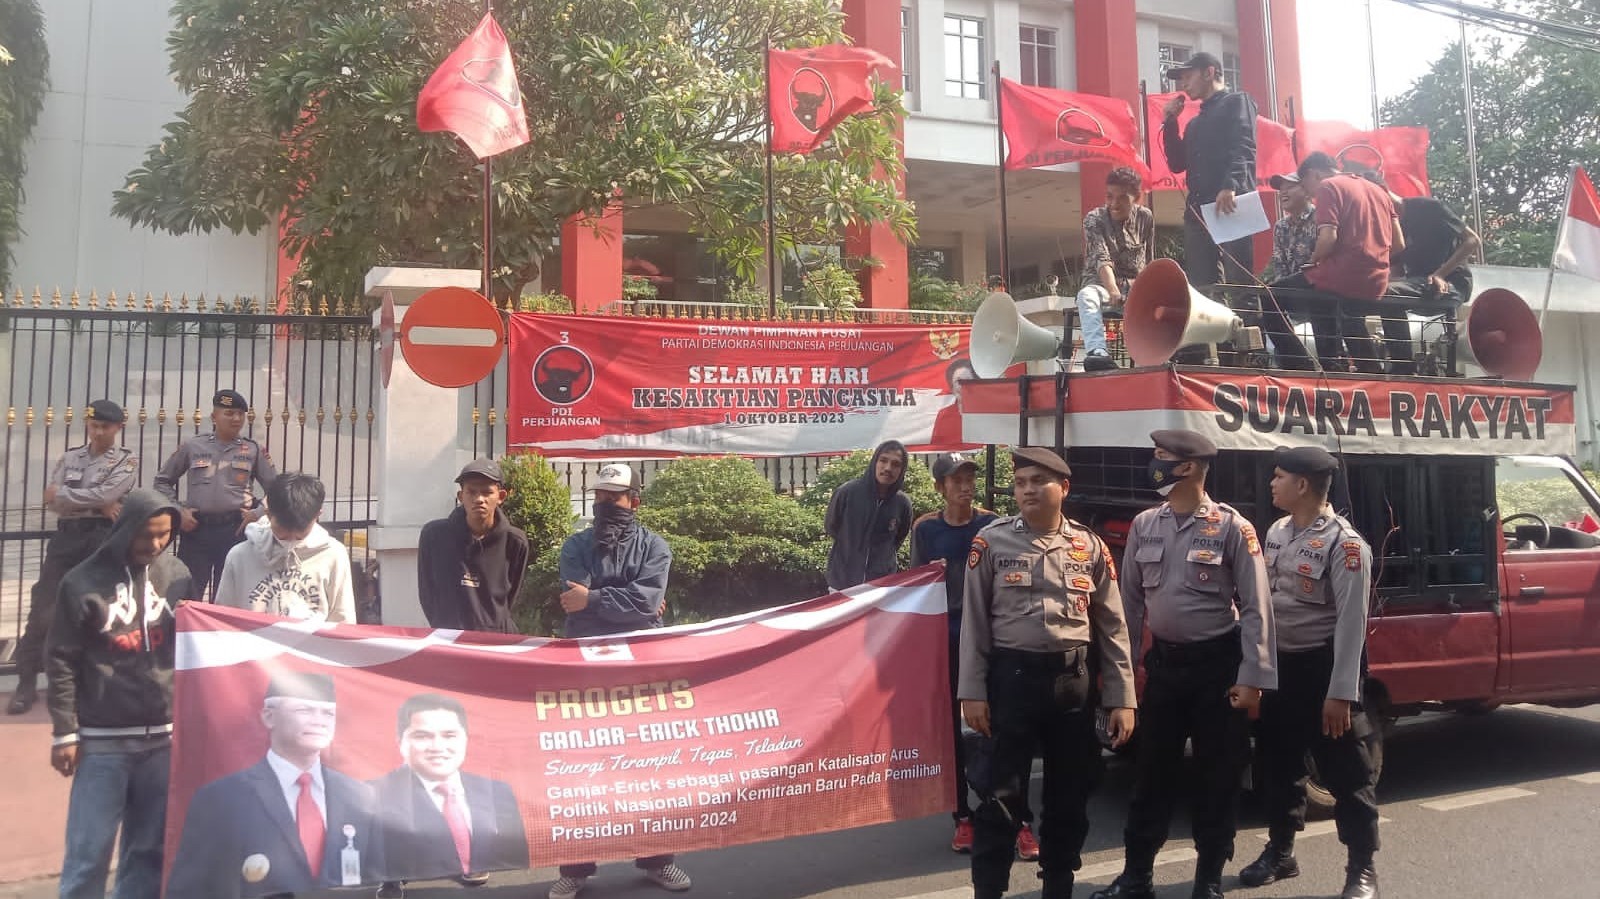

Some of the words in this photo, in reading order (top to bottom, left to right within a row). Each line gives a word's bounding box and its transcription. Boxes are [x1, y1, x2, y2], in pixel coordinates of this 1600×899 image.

[559, 331, 569, 344] 3
[698, 325, 749, 336] DEWAN
[753, 327, 818, 338] PIMPINAN
[821, 328, 862, 339] PUSAT
[662, 338, 699, 349] PARTAI
[702, 339, 767, 350] DEMOKRASI
[769, 340, 825, 350] INDONESIA
[828, 341, 893, 351] PERJUANGAN
[688, 365, 803, 384] SELAMAT
[811, 367, 869, 385] HARI
[632, 387, 779, 409] KESAKTIAN
[787, 387, 916, 407] PANCASILA
[551, 407, 573, 416] PDI
[725, 413, 731, 424] 1
[737, 413, 808, 424] OKTOBER
[812, 412, 845, 424] 2023
[1213, 382, 1377, 437] SUARA
[1389, 389, 1553, 440] RAKYAT
[522, 417, 600, 427] PERJUANGAN
[1192, 538, 1223, 548] POLRI
[999, 559, 1029, 568] ADITYA
[1298, 548, 1324, 561] POLRI
[248, 573, 274, 602] NEW
[277, 568, 312, 585] YORK
[535, 679, 695, 721] PROGETS
[539, 719, 701, 751] GANJAR-ERICK
[704, 708, 780, 735] THOHIR
[544, 759, 605, 777] Sinergi
[690, 746, 738, 765] Tegas,
[744, 736, 804, 756] Teladan
[547, 779, 665, 800] Ganjar-Erick
[666, 770, 734, 789] sebagai
[739, 761, 814, 784] pasangan
[818, 751, 886, 772] Katalisator
[890, 748, 919, 761] Arus
[549, 800, 609, 820] Politik
[614, 794, 692, 813] Nasional
[698, 789, 731, 806] Dan
[737, 781, 811, 802] Kemitraan
[816, 777, 847, 792] Baru
[850, 773, 881, 787] Pada
[885, 763, 941, 781] Pemilihan
[551, 822, 634, 842] Presiden
[640, 817, 695, 833] Tahun
[700, 810, 737, 828] 2024
